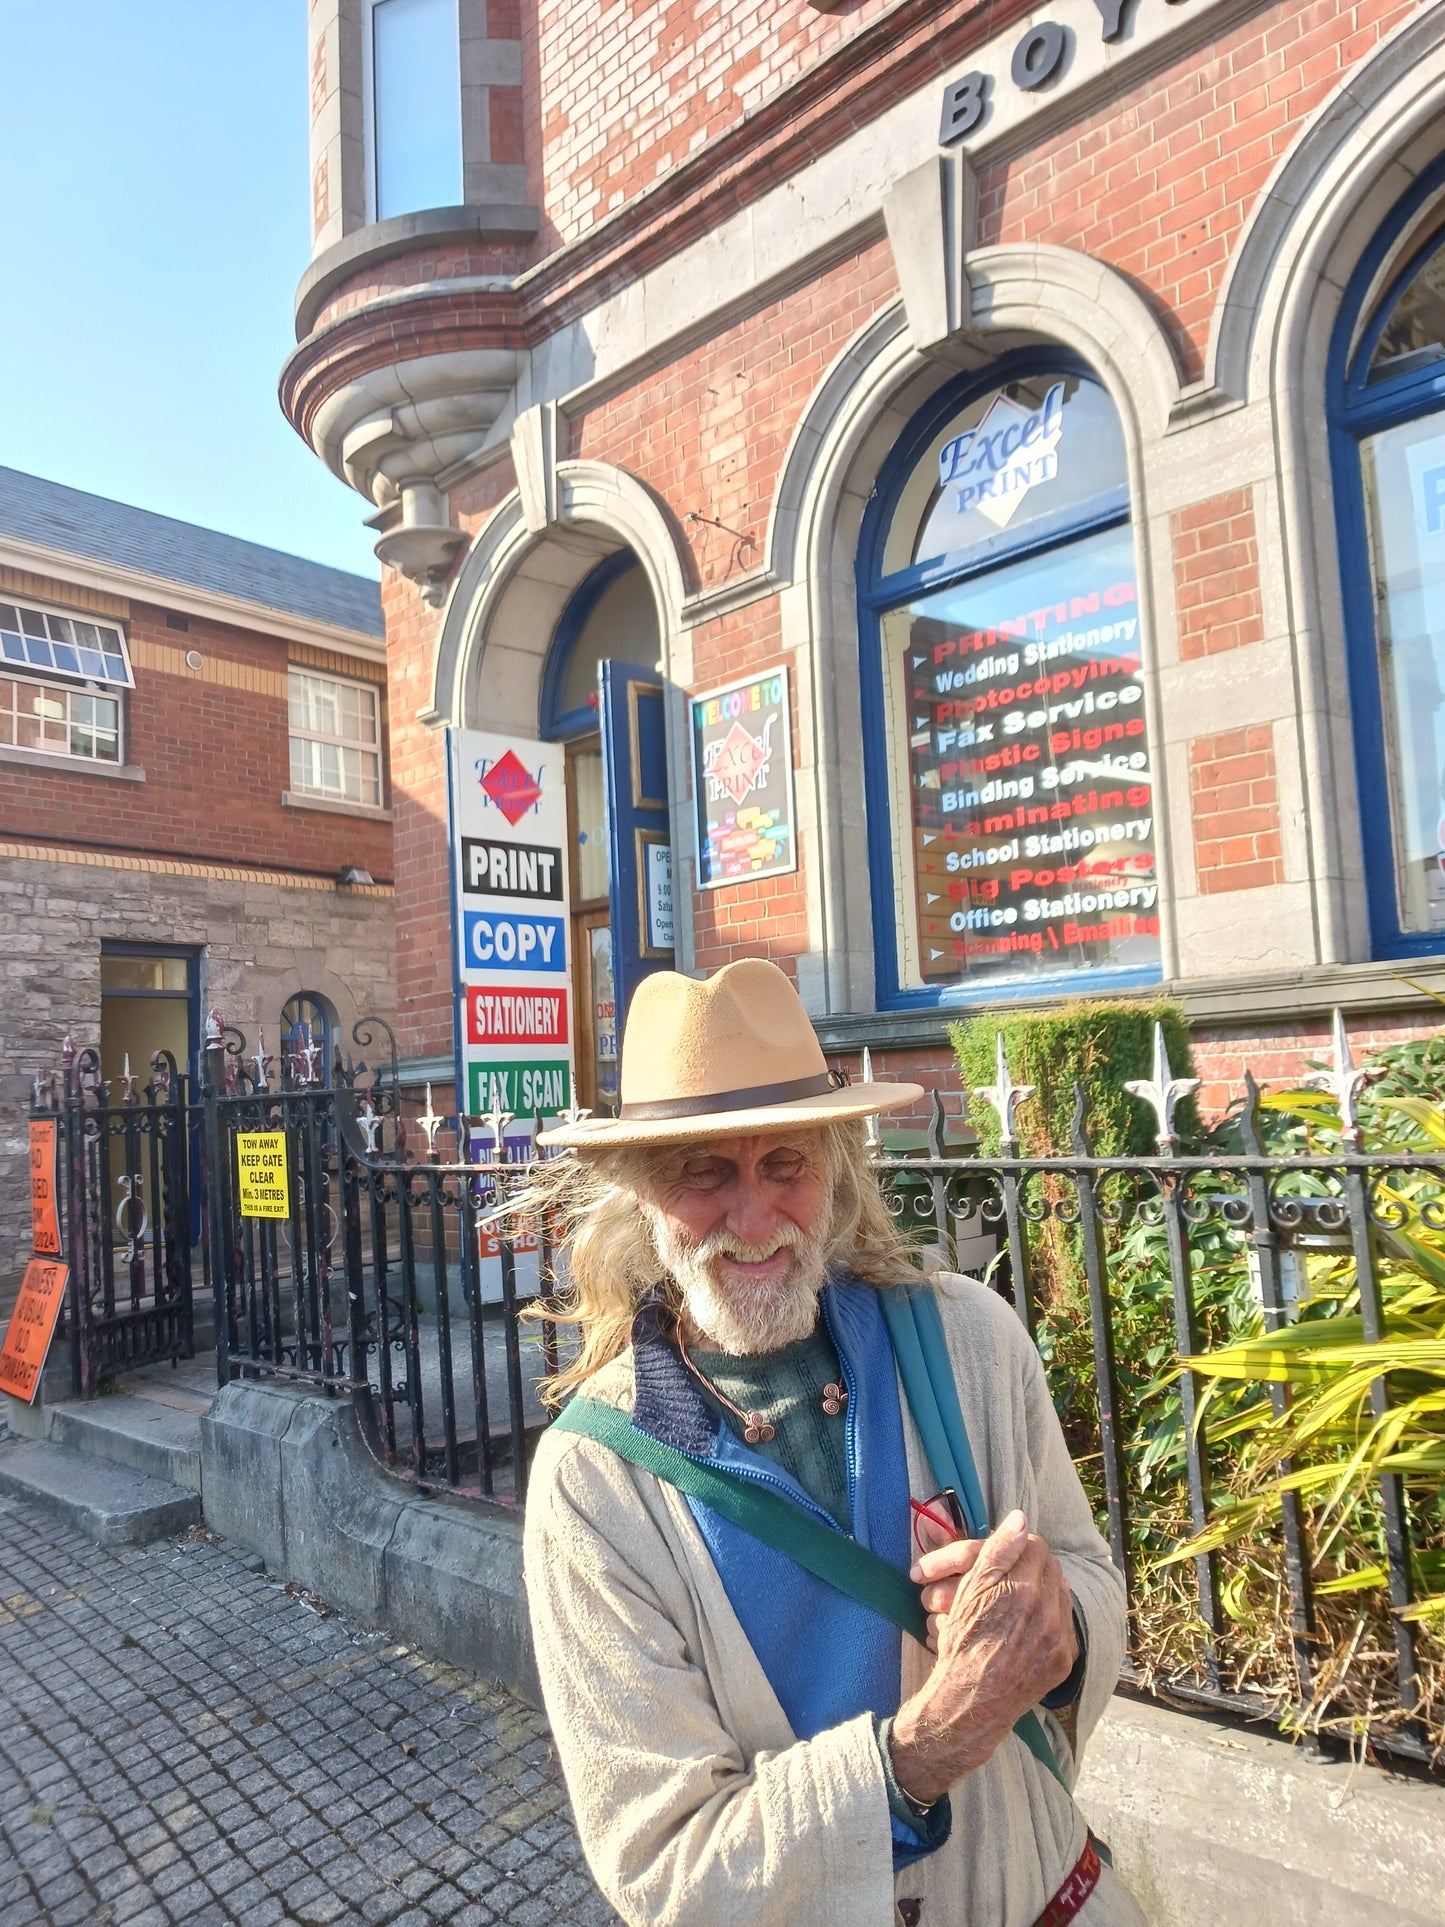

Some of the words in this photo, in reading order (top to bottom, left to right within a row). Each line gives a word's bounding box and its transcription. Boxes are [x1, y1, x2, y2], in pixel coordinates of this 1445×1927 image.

[938, 0, 1187, 147] BOY
[941, 384, 1061, 485] Excel
[958, 453, 1055, 515] PRINT
[933, 582, 1136, 664] PRINTING
[935, 652, 1020, 694] Wedding
[1023, 617, 1138, 666] Stationery
[695, 685, 761, 728] WELCOME
[762, 678, 782, 706] TO
[936, 652, 1141, 724] Photocopying
[937, 722, 994, 754] Fax
[1003, 684, 1142, 735] Service
[939, 742, 1041, 782] Plastic
[1050, 717, 1145, 754] Signs
[474, 758, 546, 794] Excel
[710, 763, 769, 801] PRINT
[942, 775, 1034, 813] Binding
[483, 794, 543, 815] PRINT
[944, 785, 1151, 841] Laminating
[469, 844, 555, 893] PRINT
[656, 851, 672, 863] OPE
[946, 841, 1019, 872] School
[1025, 818, 1152, 858] Stationery
[948, 878, 999, 900] Big
[1010, 853, 1154, 891] Posters
[950, 906, 1018, 931] Office
[1024, 884, 1158, 921] Stationery
[472, 919, 556, 963] COPY
[953, 930, 1044, 957] Scanning
[1063, 913, 1160, 944] Emailing
[475, 995, 560, 1036] STATIONERY
[478, 1070, 510, 1111] FAX
[522, 1069, 564, 1110] SCAN
[241, 1155, 260, 1166] KEEP
[262, 1155, 283, 1166] GATE
[242, 1139, 257, 1149] TOW
[259, 1139, 278, 1149] AWAY
[250, 1172, 274, 1183] CLEAR
[254, 1188, 259, 1200] 3
[260, 1189, 284, 1200] METRES
